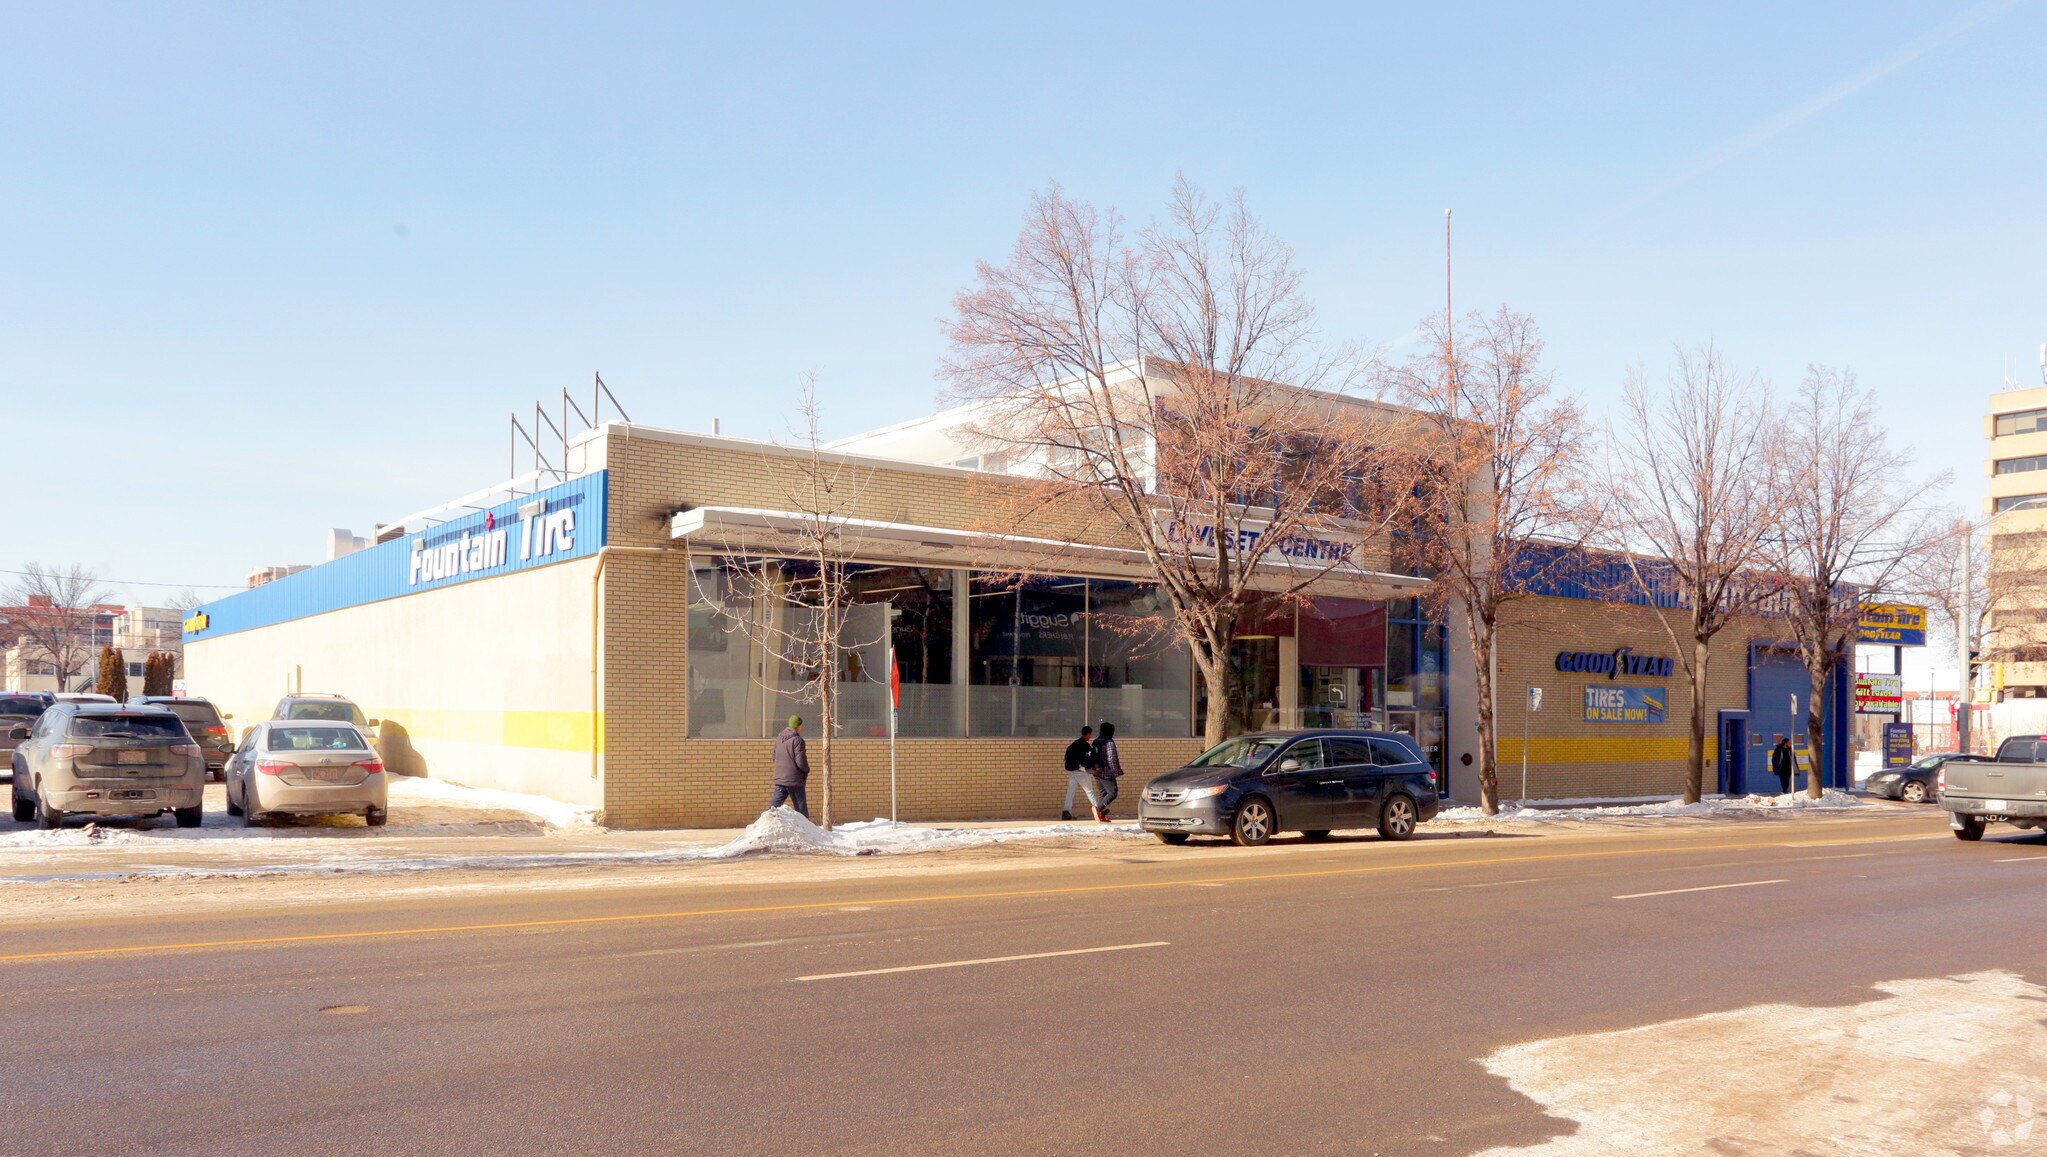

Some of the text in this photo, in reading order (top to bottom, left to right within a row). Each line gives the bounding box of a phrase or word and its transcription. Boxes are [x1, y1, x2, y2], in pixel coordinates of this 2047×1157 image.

[409, 497, 575, 586] Fountain Tire
[1281, 538, 1354, 561] CENTRE
[1556, 647, 1675, 680] GOODYEAR
[1586, 688, 1625, 708] TIRES
[1586, 707, 1648, 721] ON SALE NOW!
[1421, 745, 1438, 753] UBER
